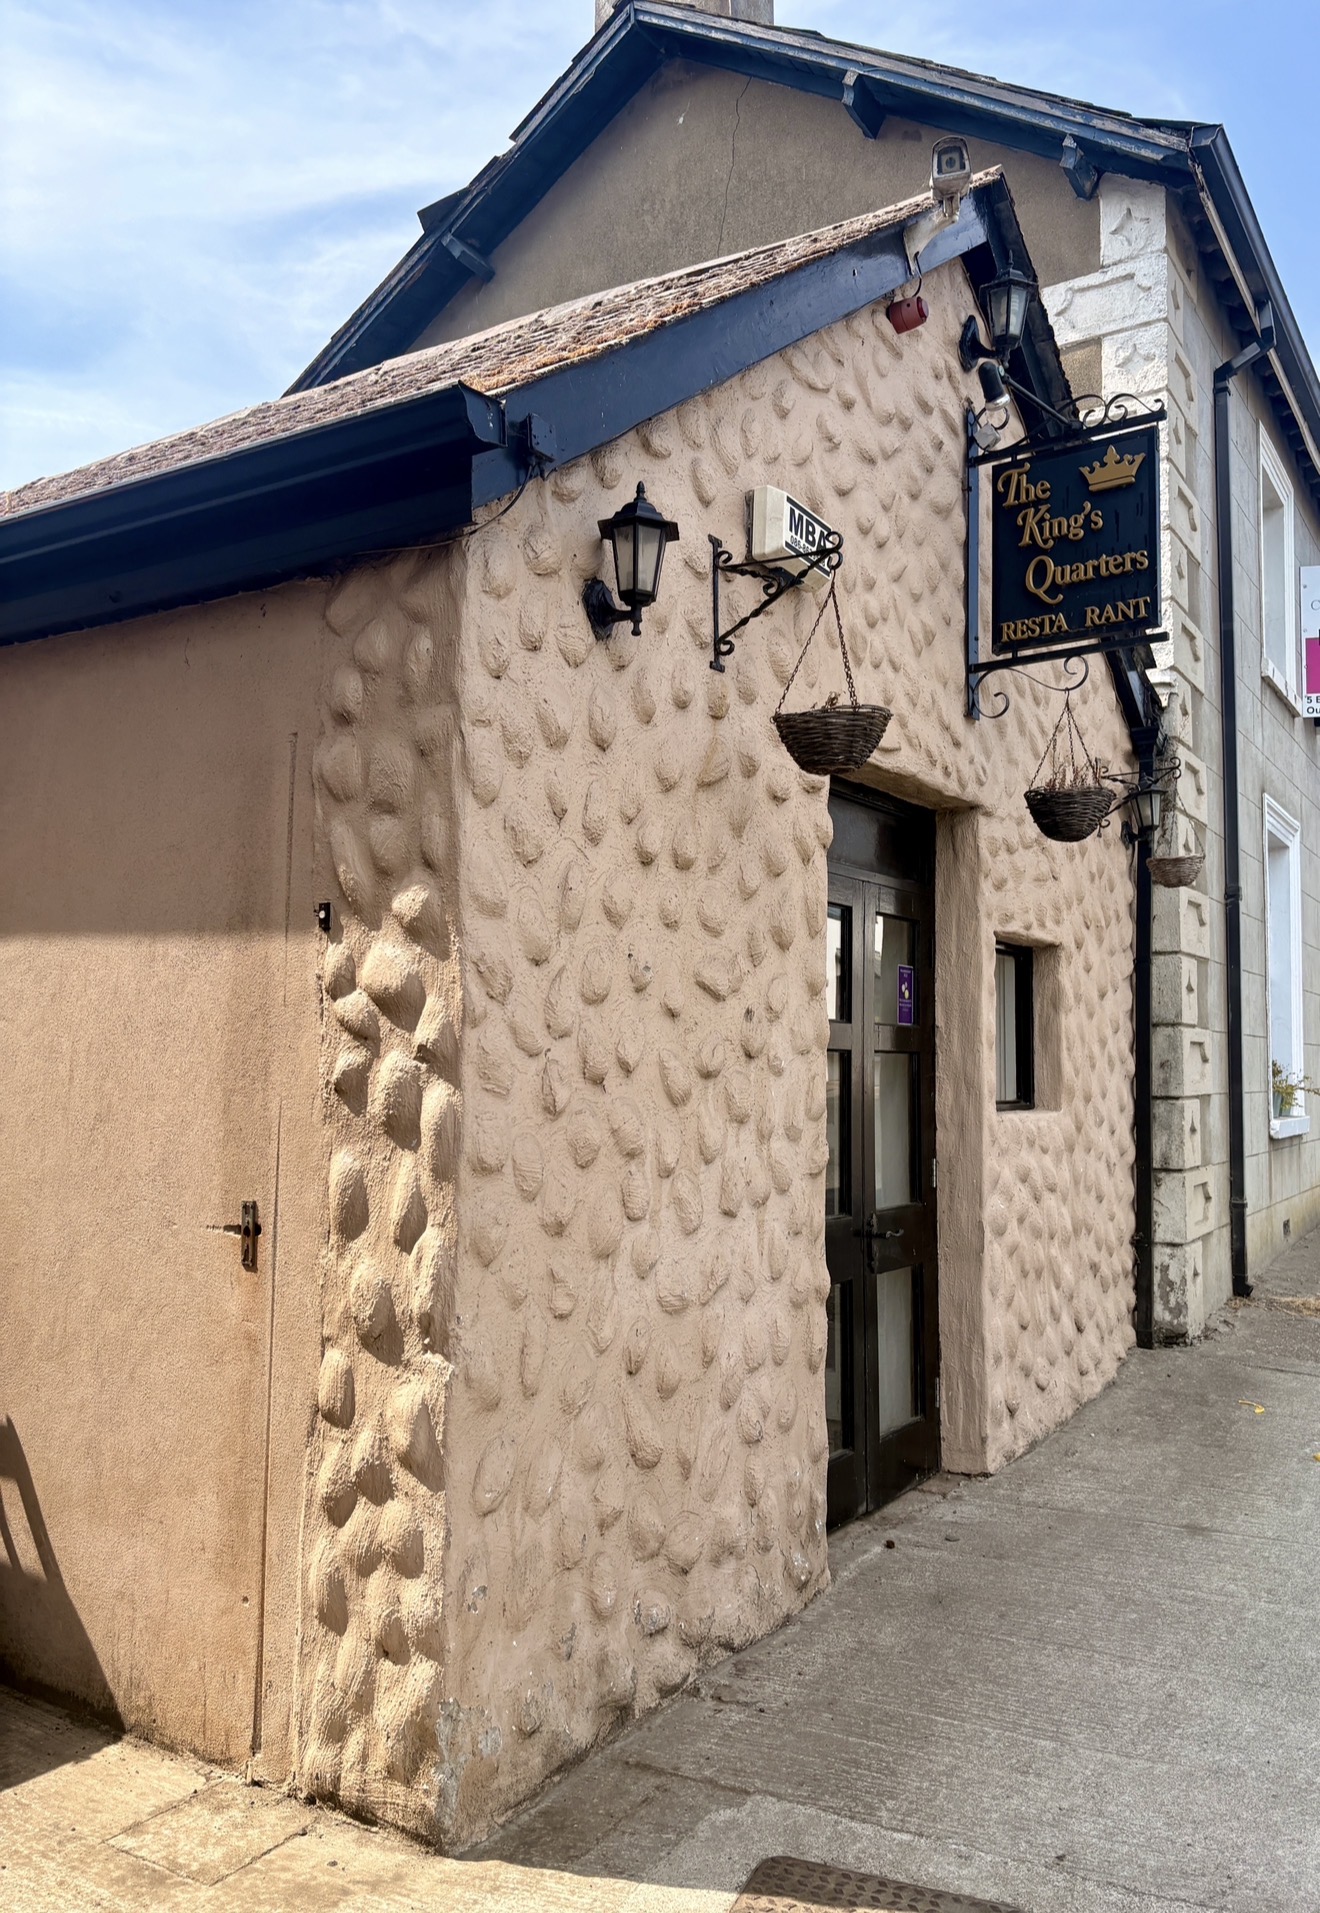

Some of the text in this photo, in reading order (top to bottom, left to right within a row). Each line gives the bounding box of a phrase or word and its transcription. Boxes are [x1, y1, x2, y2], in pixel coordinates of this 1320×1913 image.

[997, 463, 1051, 507] The
[1018, 502, 1103, 549] King's
[1026, 550, 1149, 604] Quarters
[1002, 597, 1150, 642] RESTA RANT
